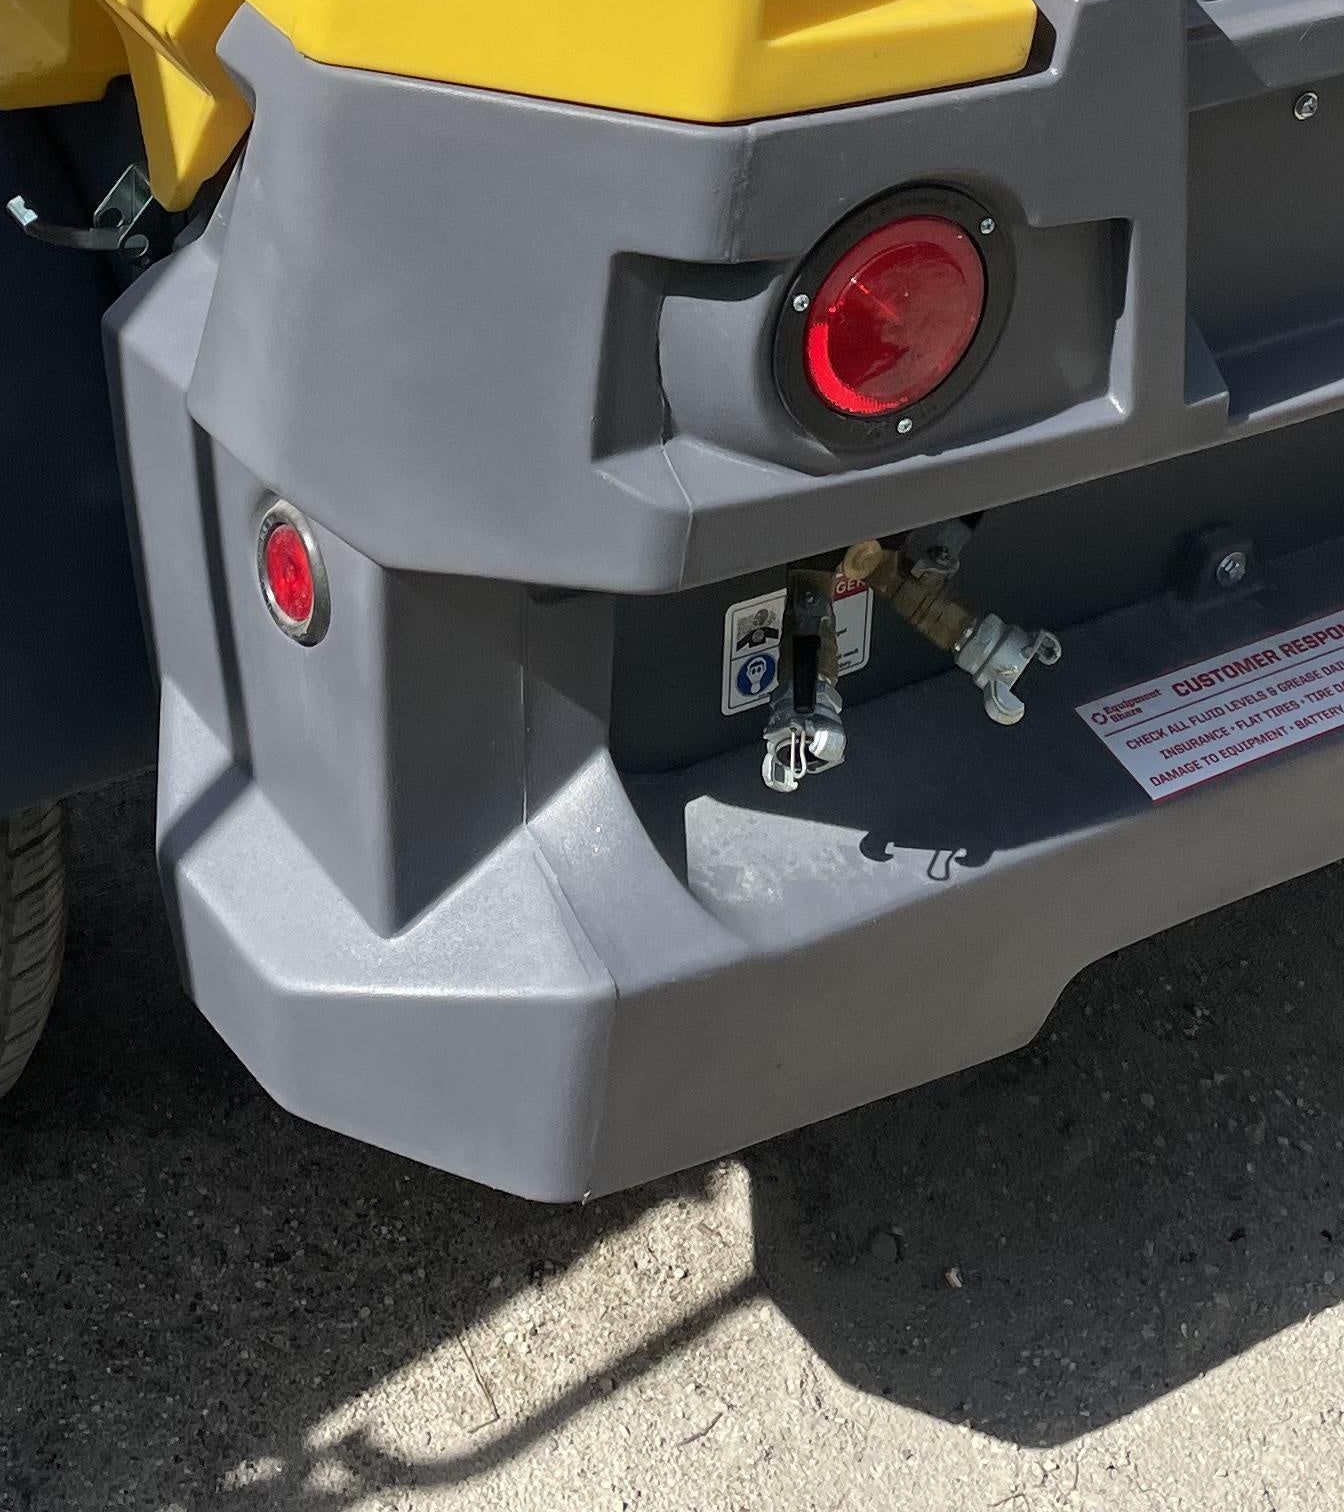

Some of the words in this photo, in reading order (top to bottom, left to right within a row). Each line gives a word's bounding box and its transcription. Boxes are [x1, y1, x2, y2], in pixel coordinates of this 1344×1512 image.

[1171, 649, 1281, 698] CUSTOMER
[1126, 727, 1168, 751] CHECK
[1167, 720, 1190, 735] ALL
[1188, 706, 1226, 727] FLUID
[1229, 690, 1268, 713] LEVELS
[1277, 670, 1322, 693] GREASE
[1159, 726, 1231, 760] INSURANCE
[1234, 712, 1264, 731] FLAT
[1262, 699, 1301, 720] TIRES
[1304, 687, 1337, 704] TIRE
[1149, 759, 1202, 787] DAMAGE
[1200, 753, 1220, 767] TO
[1220, 725, 1289, 759] EQUIPMENT
